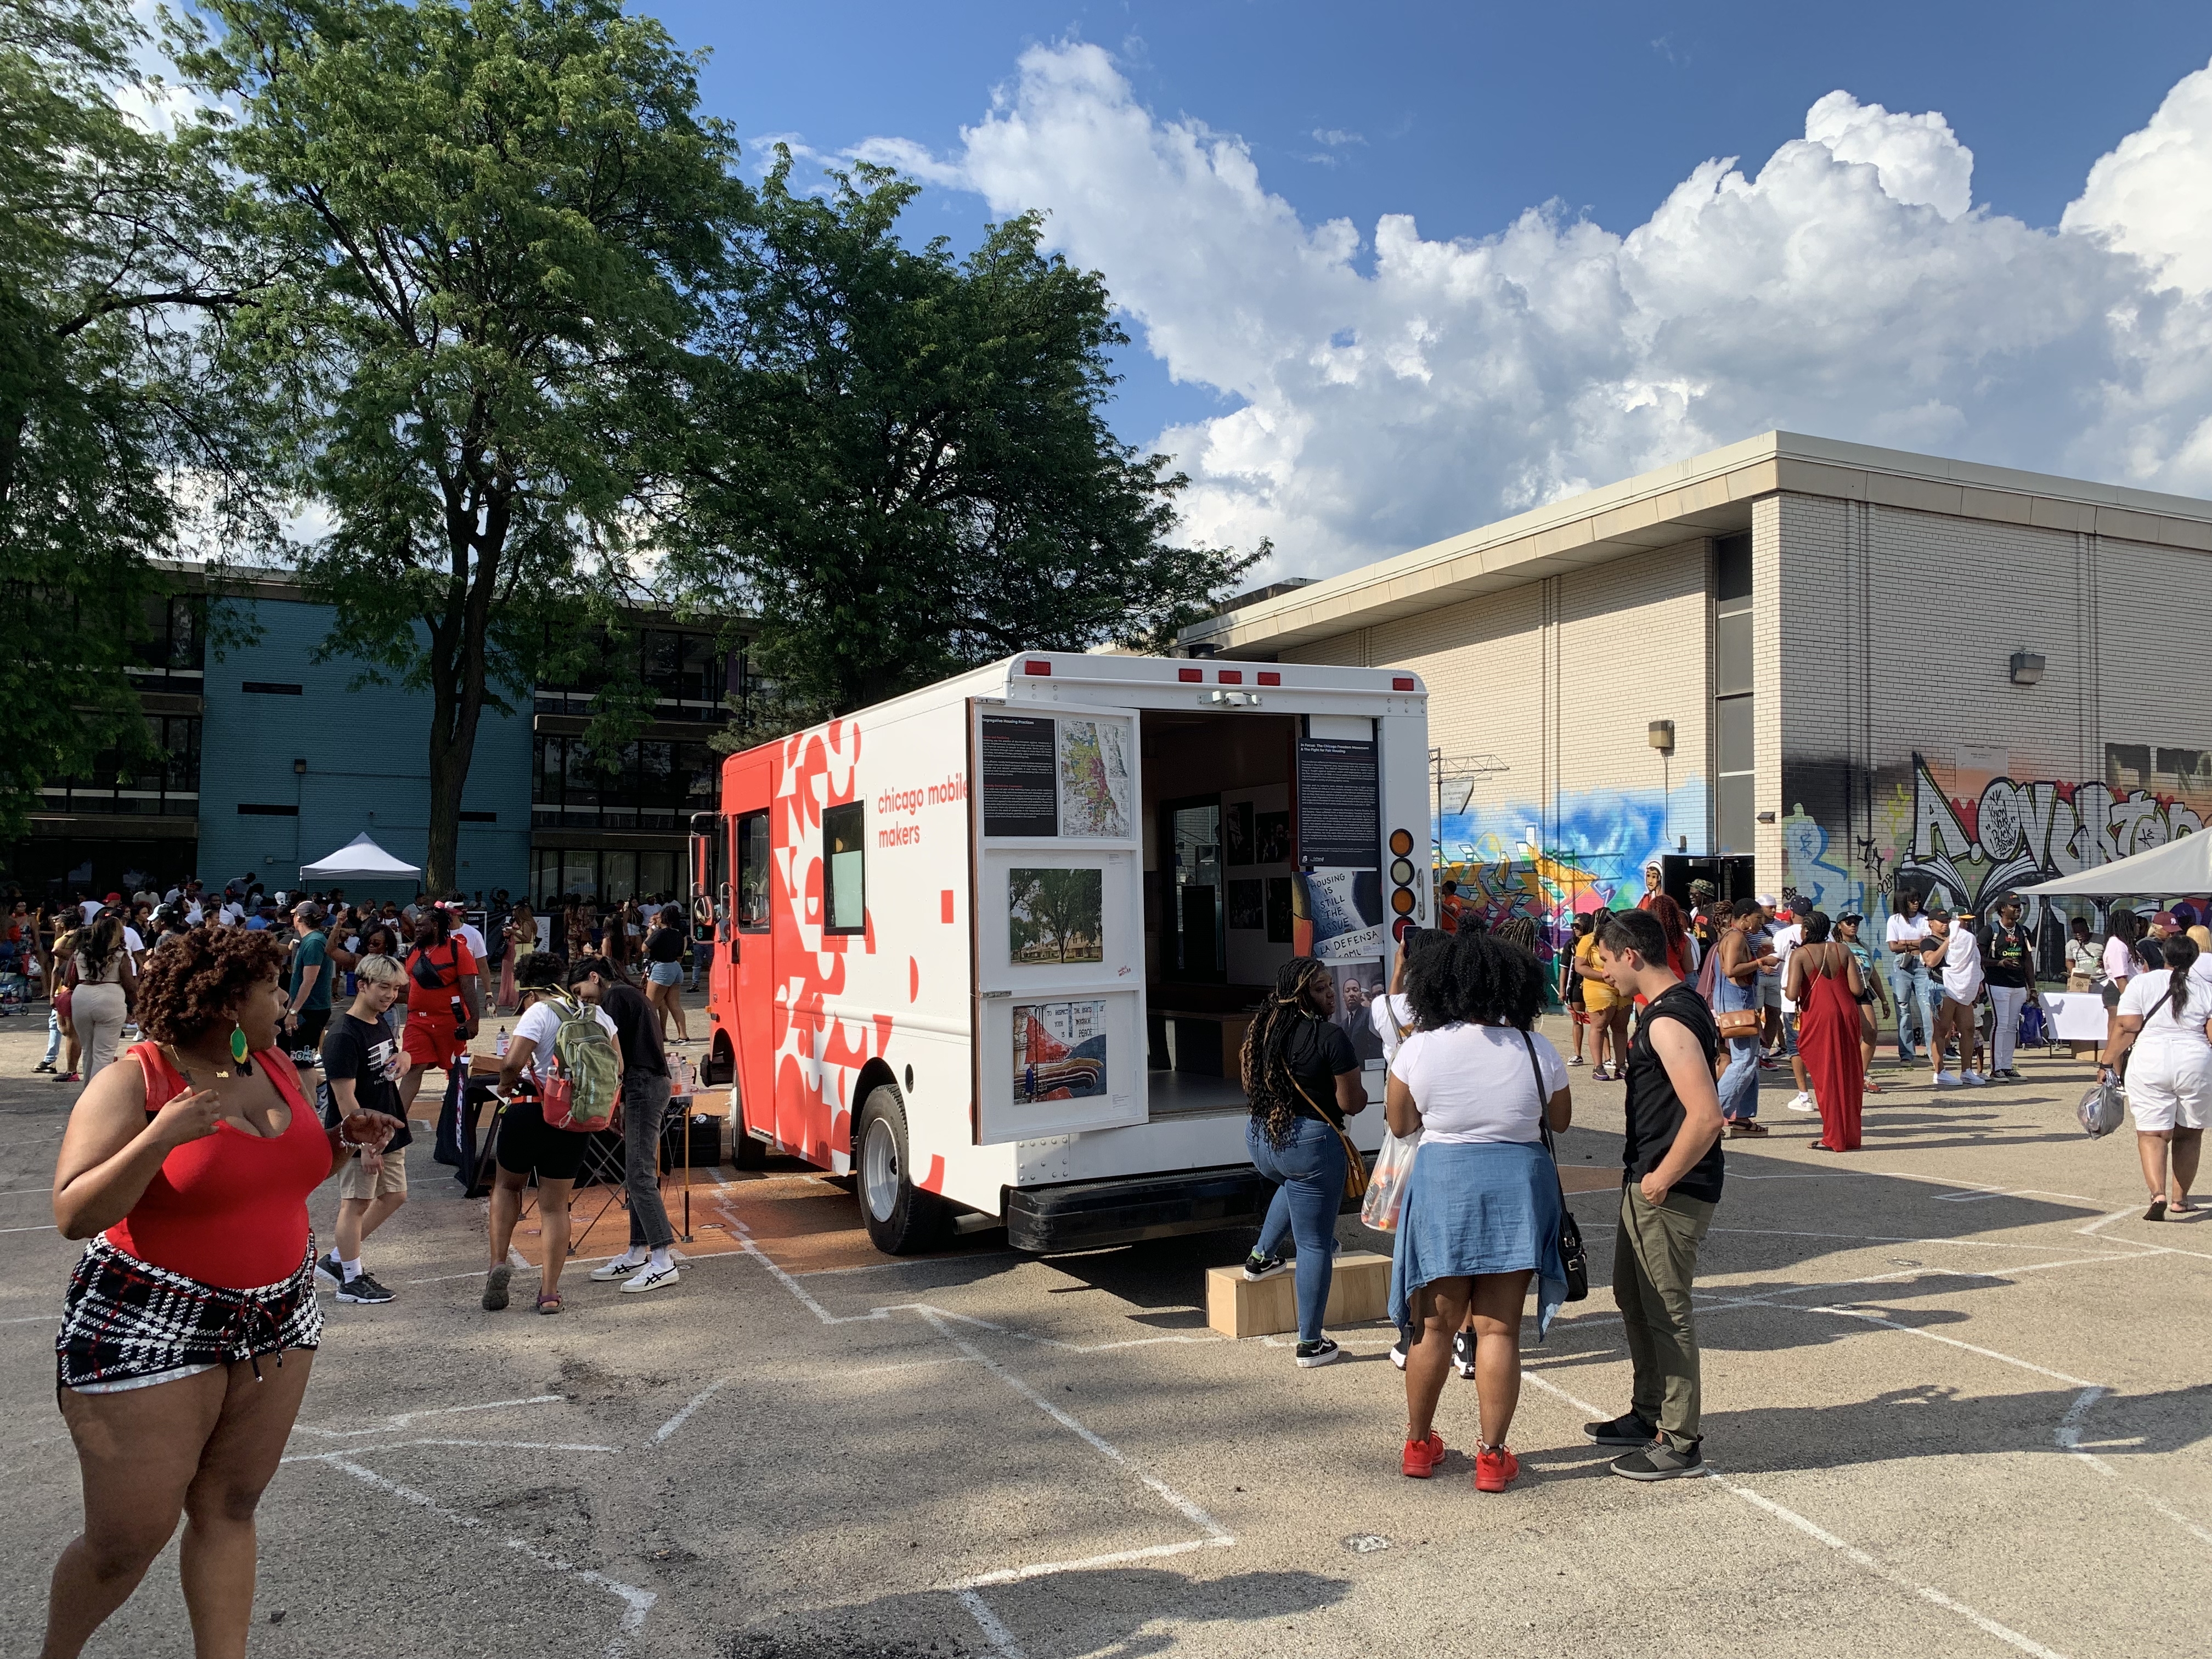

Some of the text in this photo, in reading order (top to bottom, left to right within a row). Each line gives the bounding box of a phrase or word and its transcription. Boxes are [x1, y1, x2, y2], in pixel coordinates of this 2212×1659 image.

[878, 786, 924, 816] chicago
[1988, 800, 2007, 825] KNOW
[879, 821, 920, 848] makers
[1991, 823, 2014, 848] BLACK
[1310, 873, 1345, 890] HOUSING
[1324, 887, 1333, 895] IS
[1320, 895, 1345, 909] STILL
[1324, 907, 1344, 919] THE
[1319, 917, 1350, 934] ISSUE
[1320, 946, 1330, 955] LA
[1333, 930, 1379, 950] DEFENSA
[1079, 1028, 1092, 1037] PEACE
